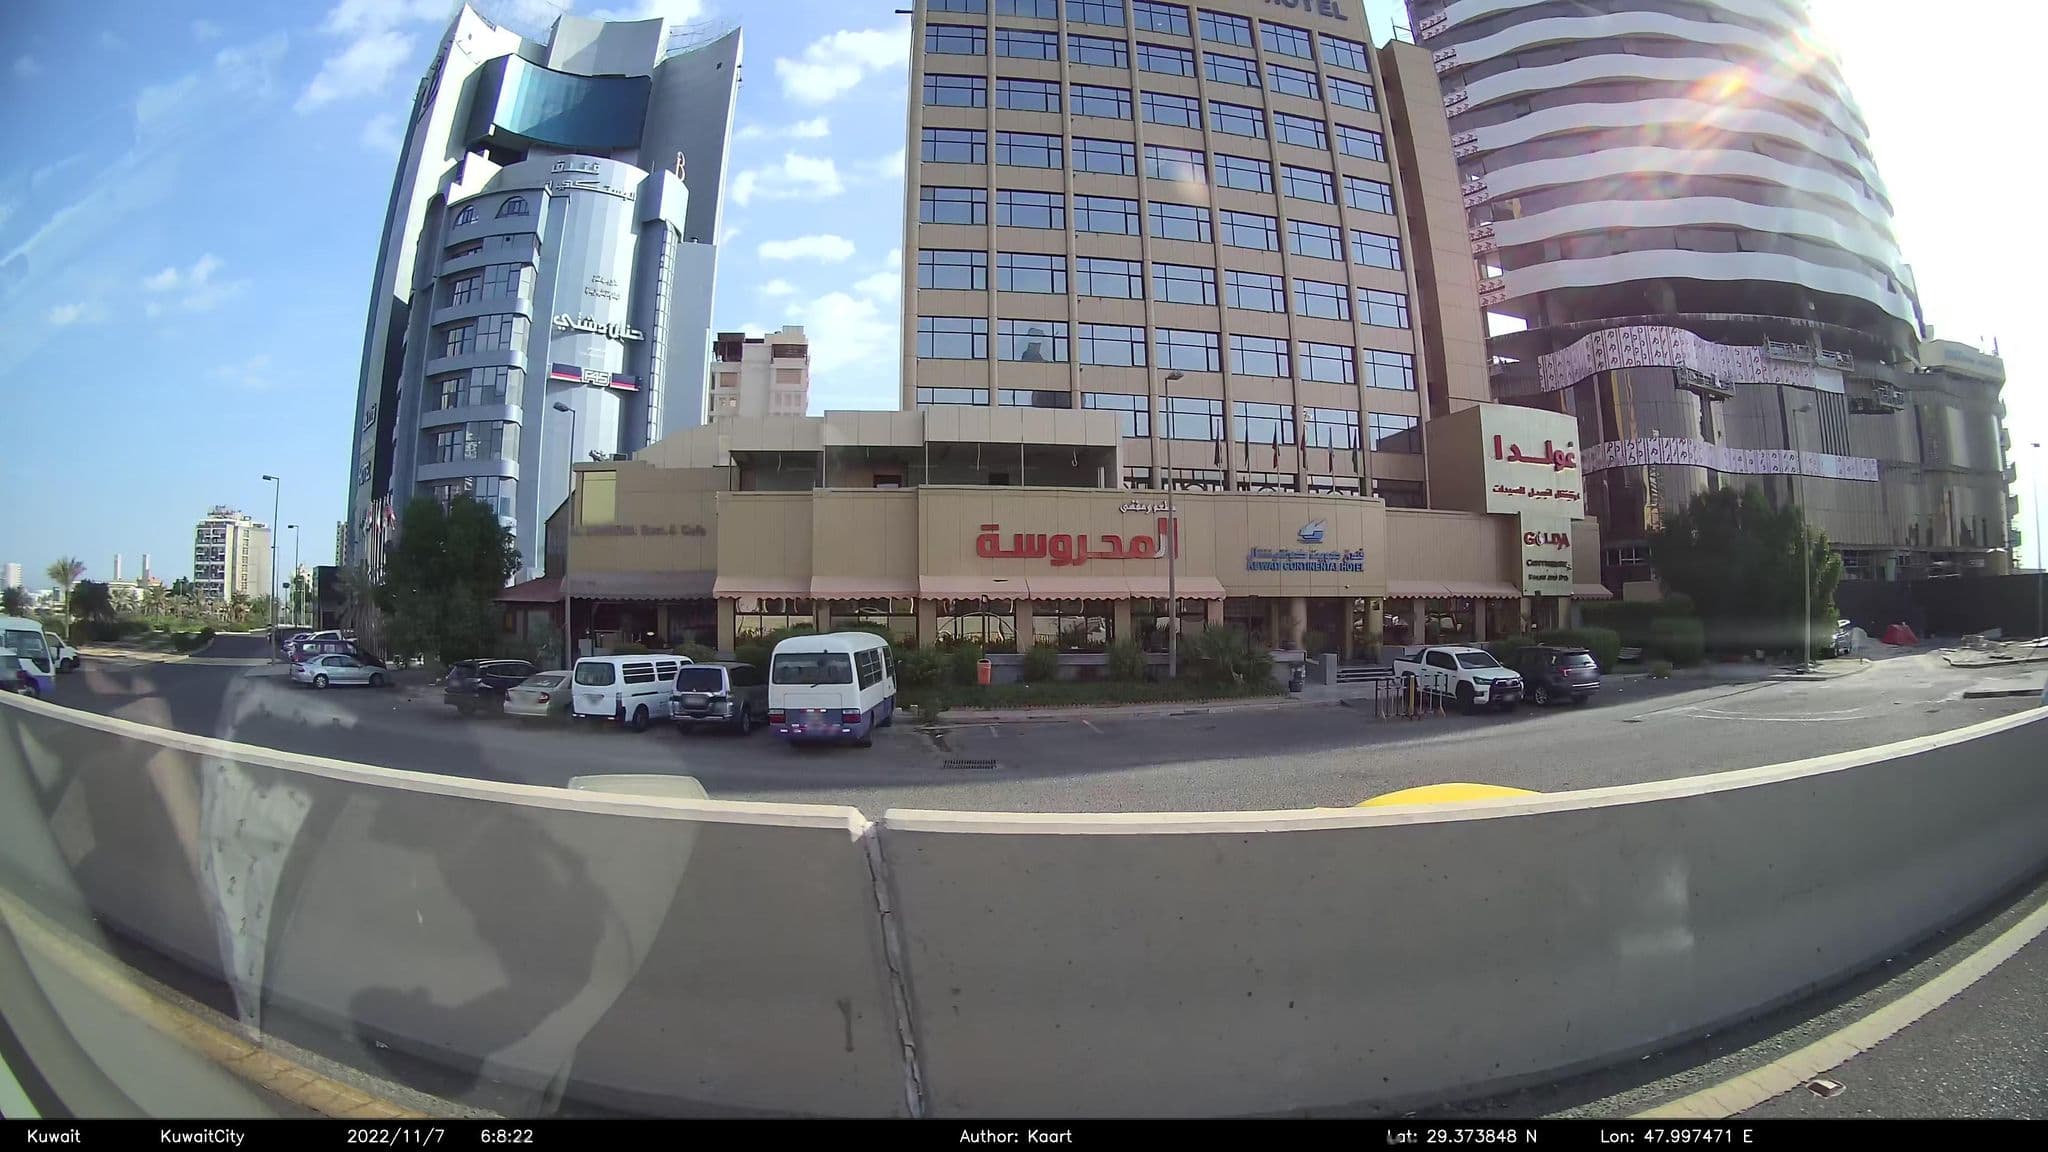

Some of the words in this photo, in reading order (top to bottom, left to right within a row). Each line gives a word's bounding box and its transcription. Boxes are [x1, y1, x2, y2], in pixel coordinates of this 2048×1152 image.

[1265, 0, 1349, 21] OTEL
[1493, 434, 1577, 472] غولدا
[976, 517, 1178, 567] المحروسة
[1524, 531, 1571, 551] GOLDA
